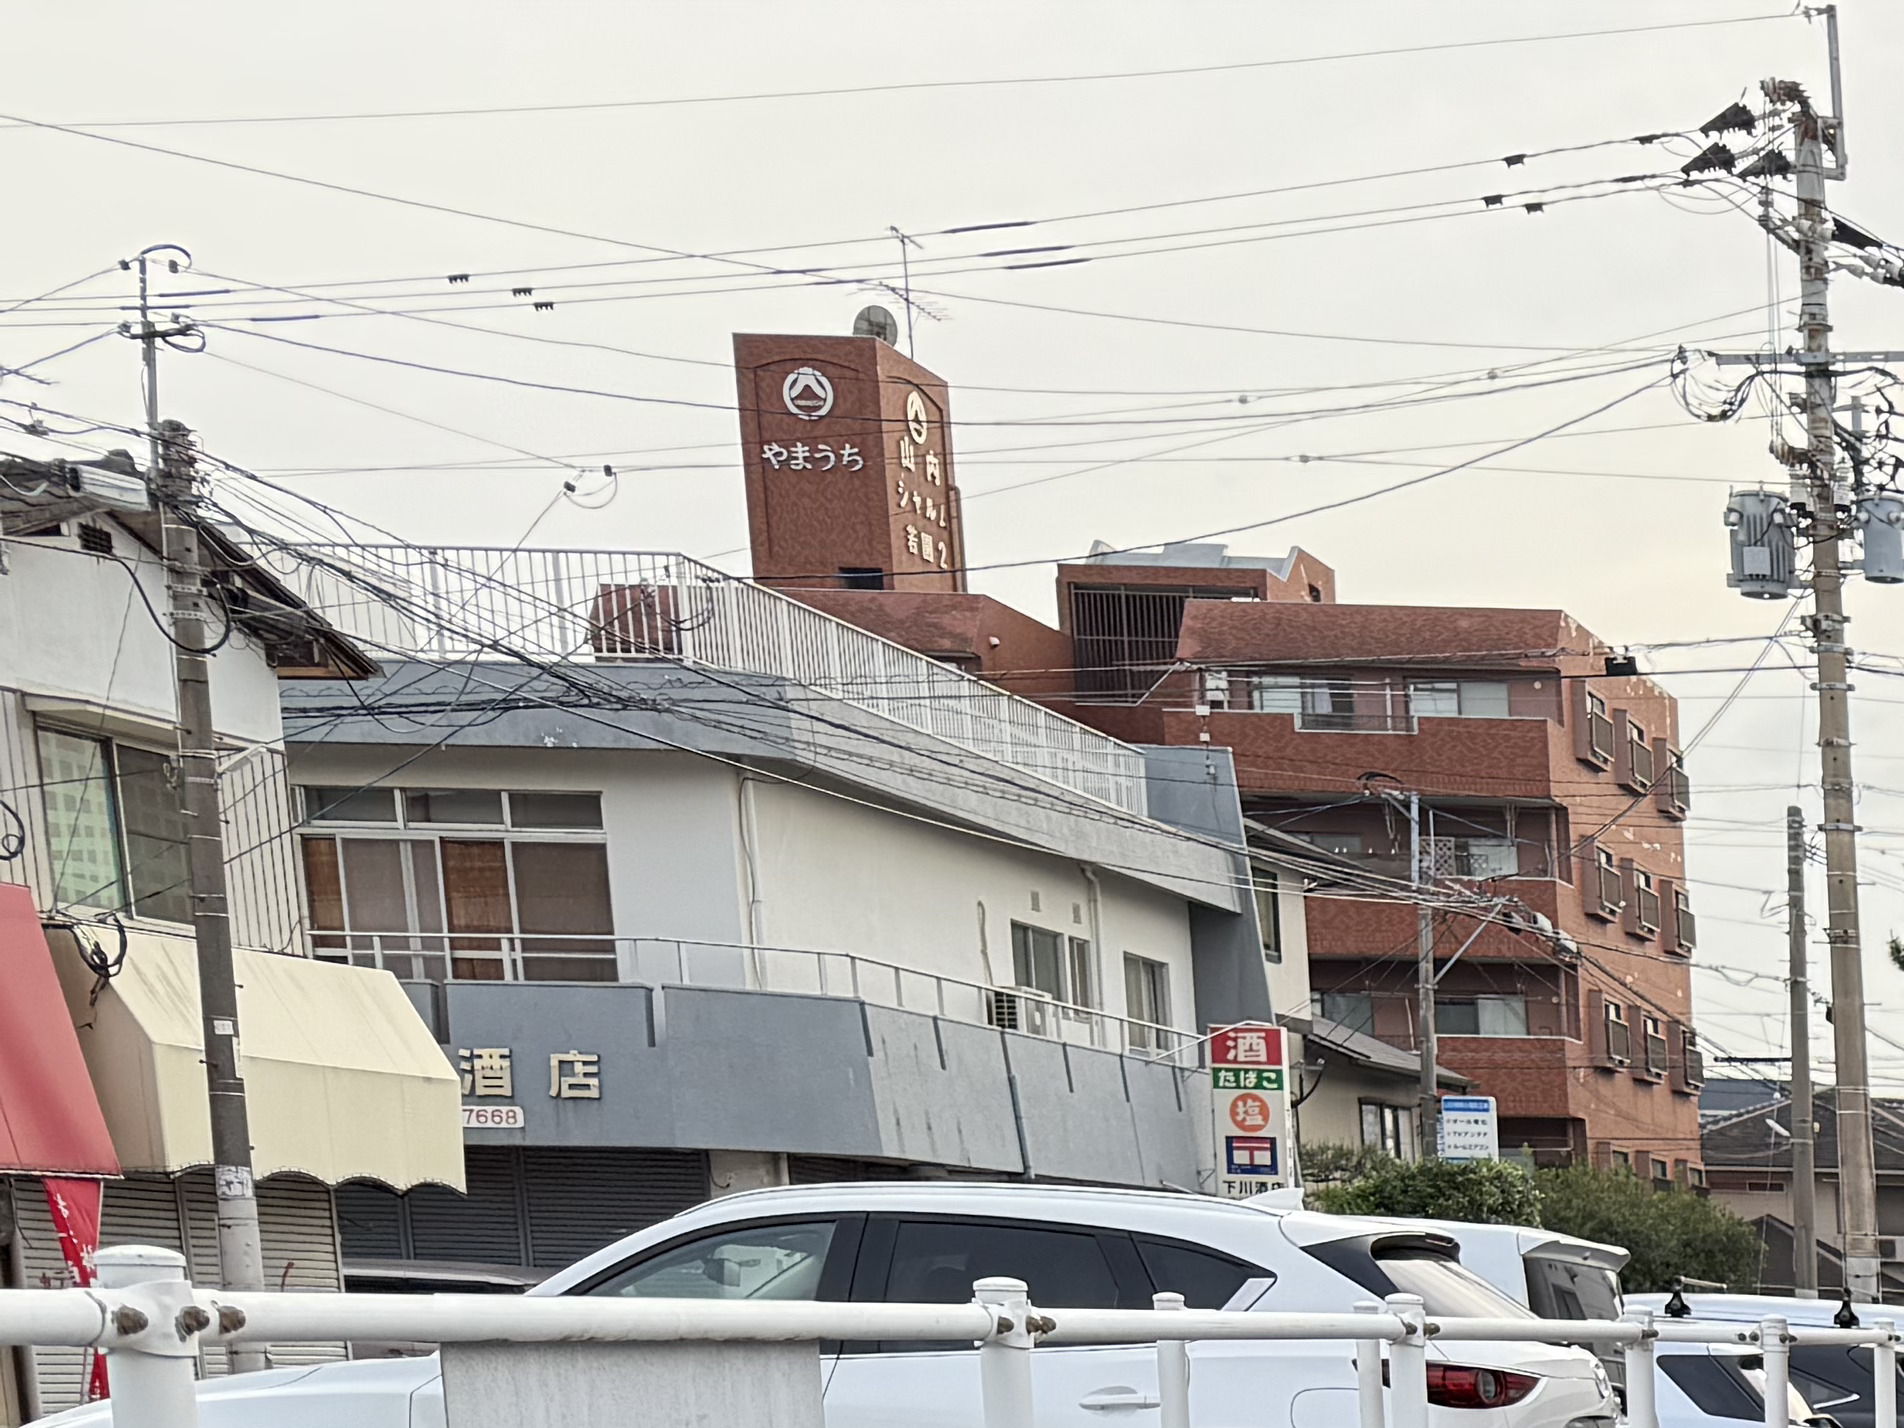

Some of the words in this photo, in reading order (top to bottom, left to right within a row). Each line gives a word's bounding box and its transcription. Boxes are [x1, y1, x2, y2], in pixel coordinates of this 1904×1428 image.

[761, 441, 864, 471] やまうち
[899, 435, 942, 487] 山内
[1225, 1031, 1268, 1062] 酒
[458, 1047, 600, 1098] 酒店
[1218, 1069, 1278, 1089] たばこ
[462, 1108, 518, 1126] 7668
[1235, 1098, 1265, 1126] 塩
